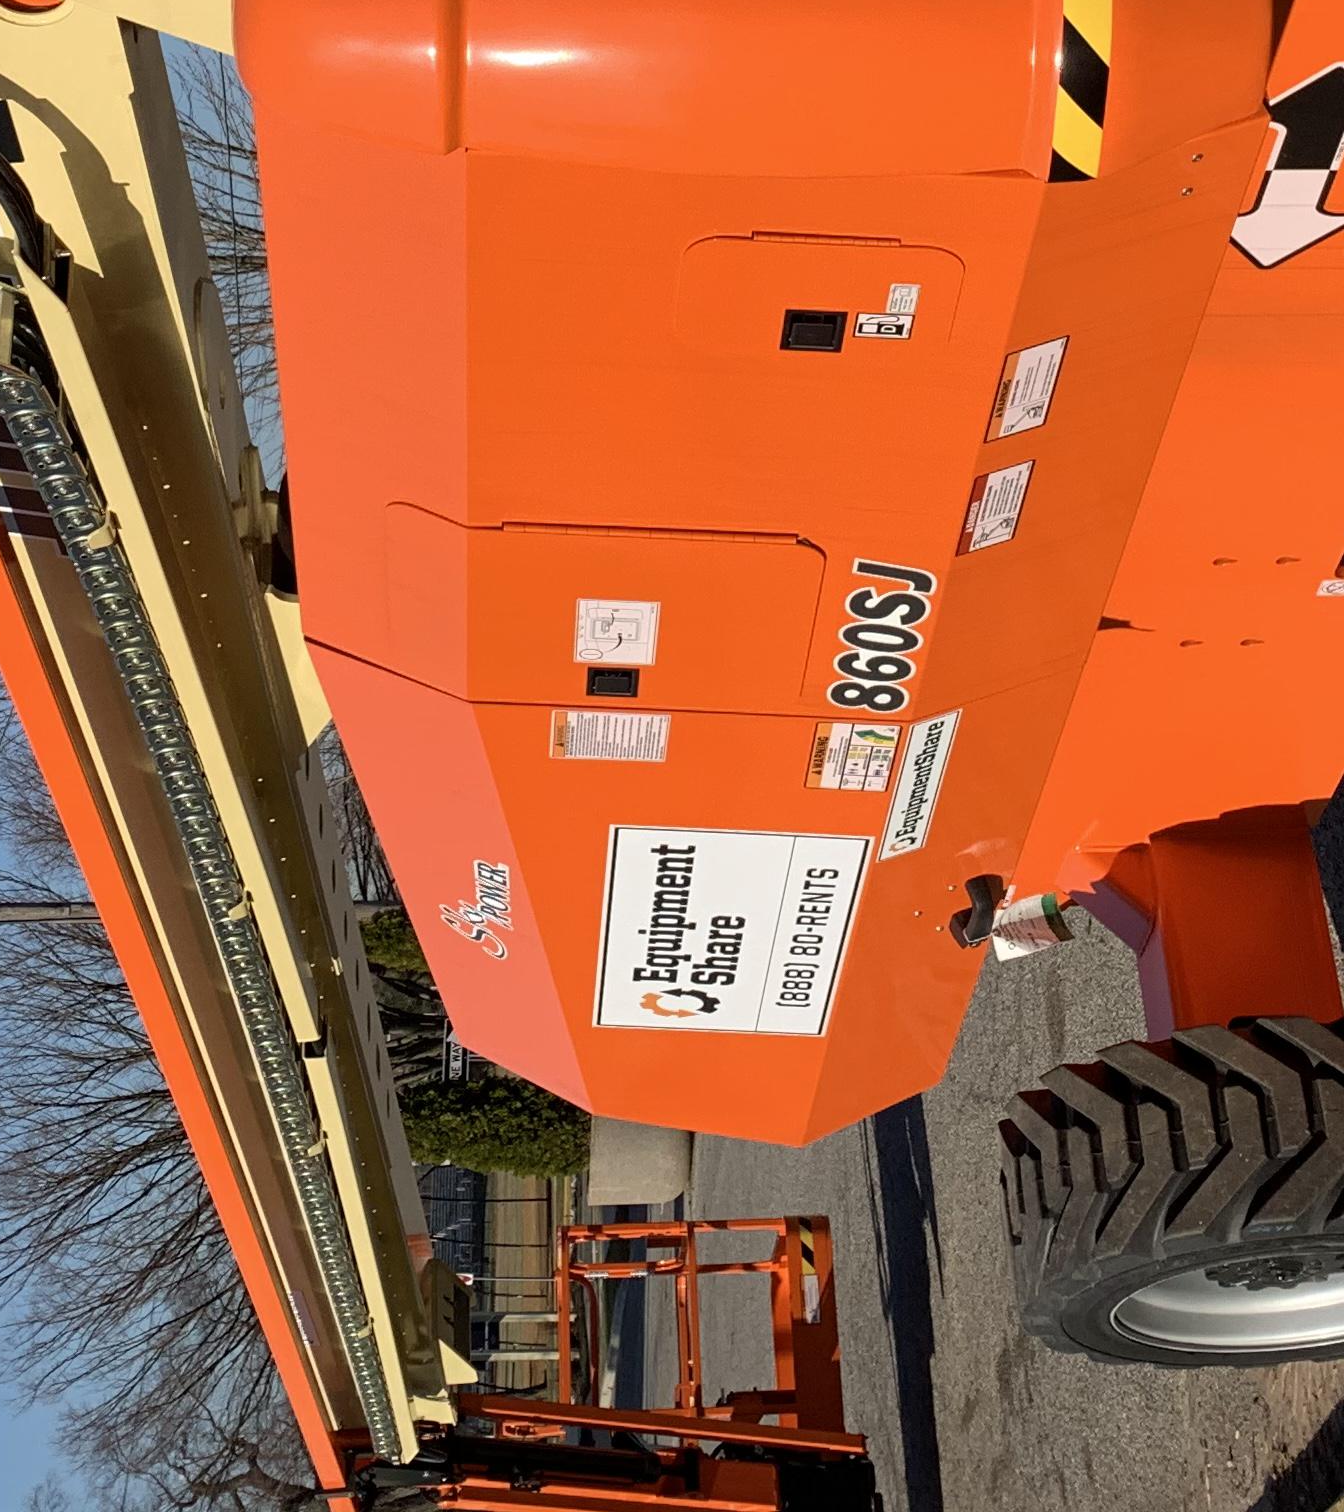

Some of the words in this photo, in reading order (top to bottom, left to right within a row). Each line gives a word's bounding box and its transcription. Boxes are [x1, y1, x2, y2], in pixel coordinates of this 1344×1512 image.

[828, 558, 935, 712] 860SJ
[811, 736, 829, 769] WARNING
[895, 720, 946, 838] EquipmentShare
[475, 861, 510, 921] POWER
[632, 845, 696, 983] Equipment
[789, 868, 840, 956] 80-RENTS
[691, 915, 746, 986] Share
[775, 962, 820, 1008] (888)
[451, 1042, 461, 1062] WAY
